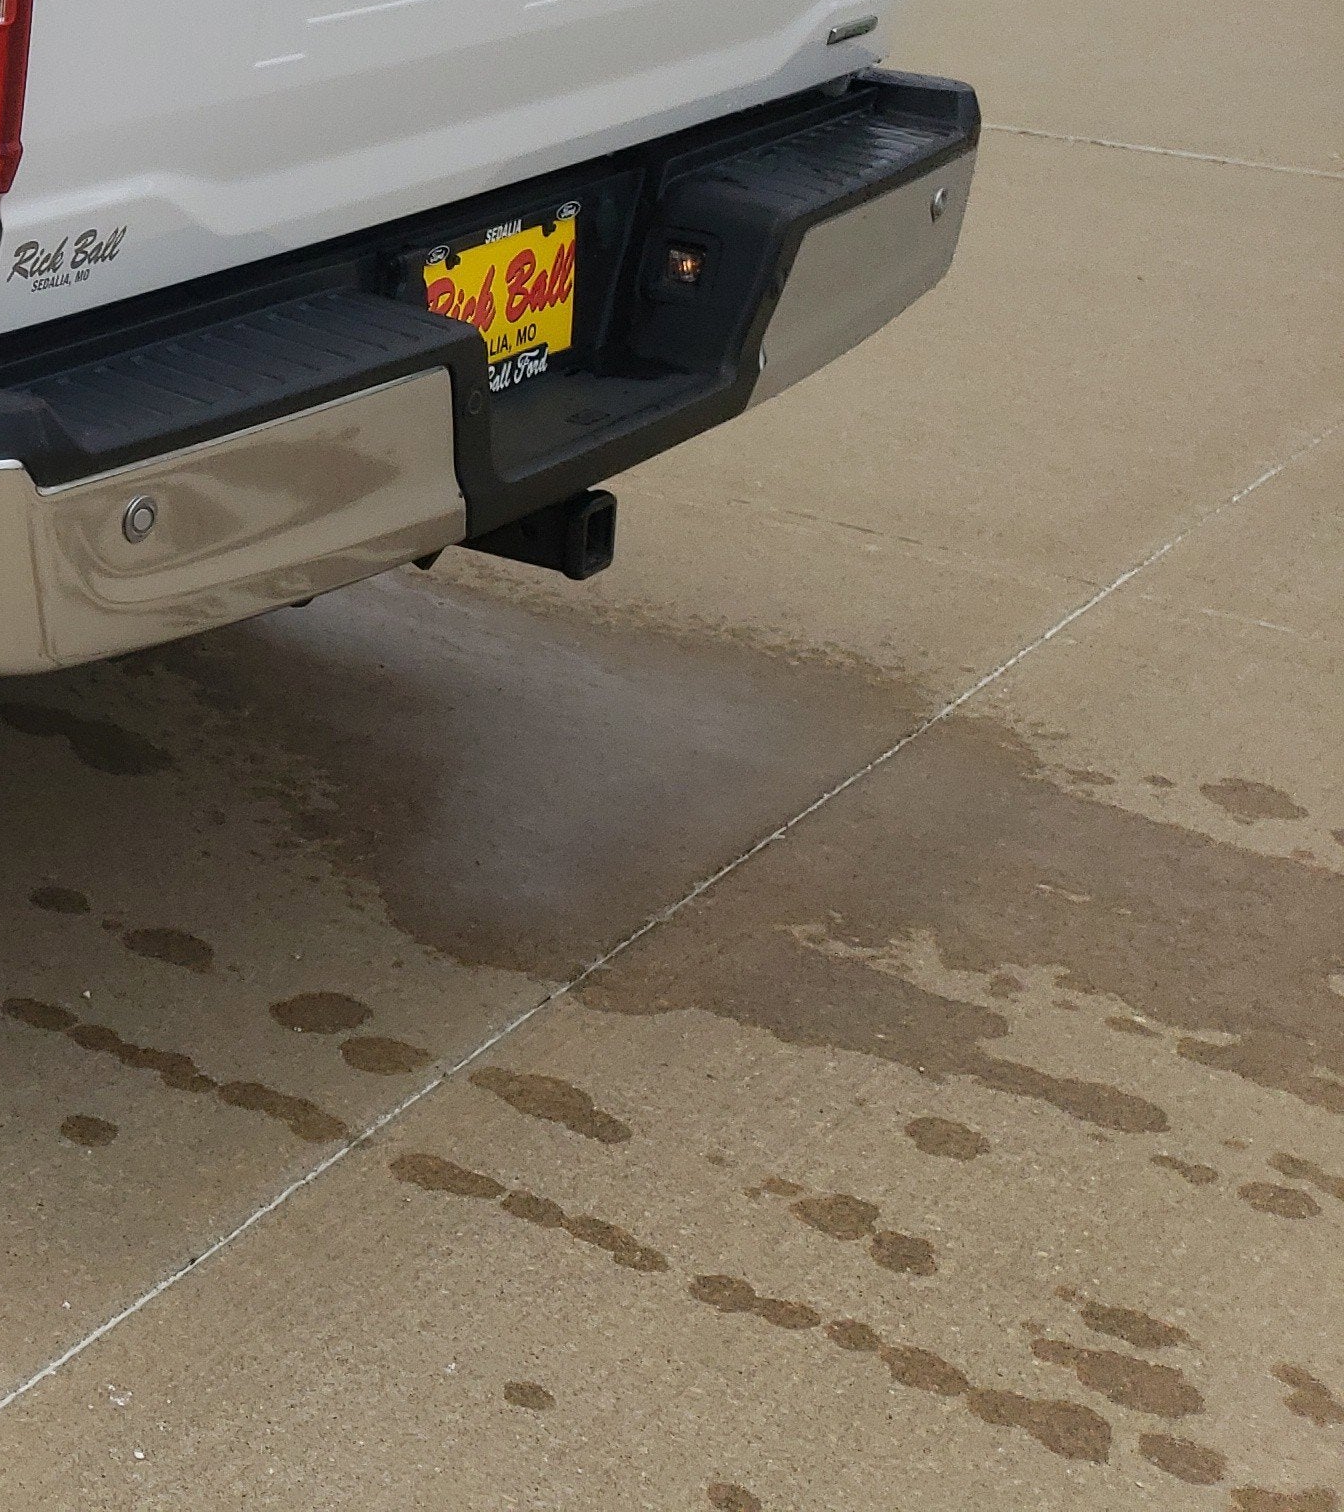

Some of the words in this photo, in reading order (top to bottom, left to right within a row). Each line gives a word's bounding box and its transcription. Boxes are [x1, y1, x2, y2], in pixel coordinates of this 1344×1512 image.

[485, 219, 522, 245] SEDALIA
[6, 236, 69, 283] Rick
[70, 225, 128, 270] Ball
[31, 273, 72, 293] SEDALIA,
[75, 268, 91, 283] MO
[505, 239, 575, 323] Ball
[488, 333, 512, 357] LIA,
[515, 322, 537, 347] MO
[513, 345, 549, 384] Ford
